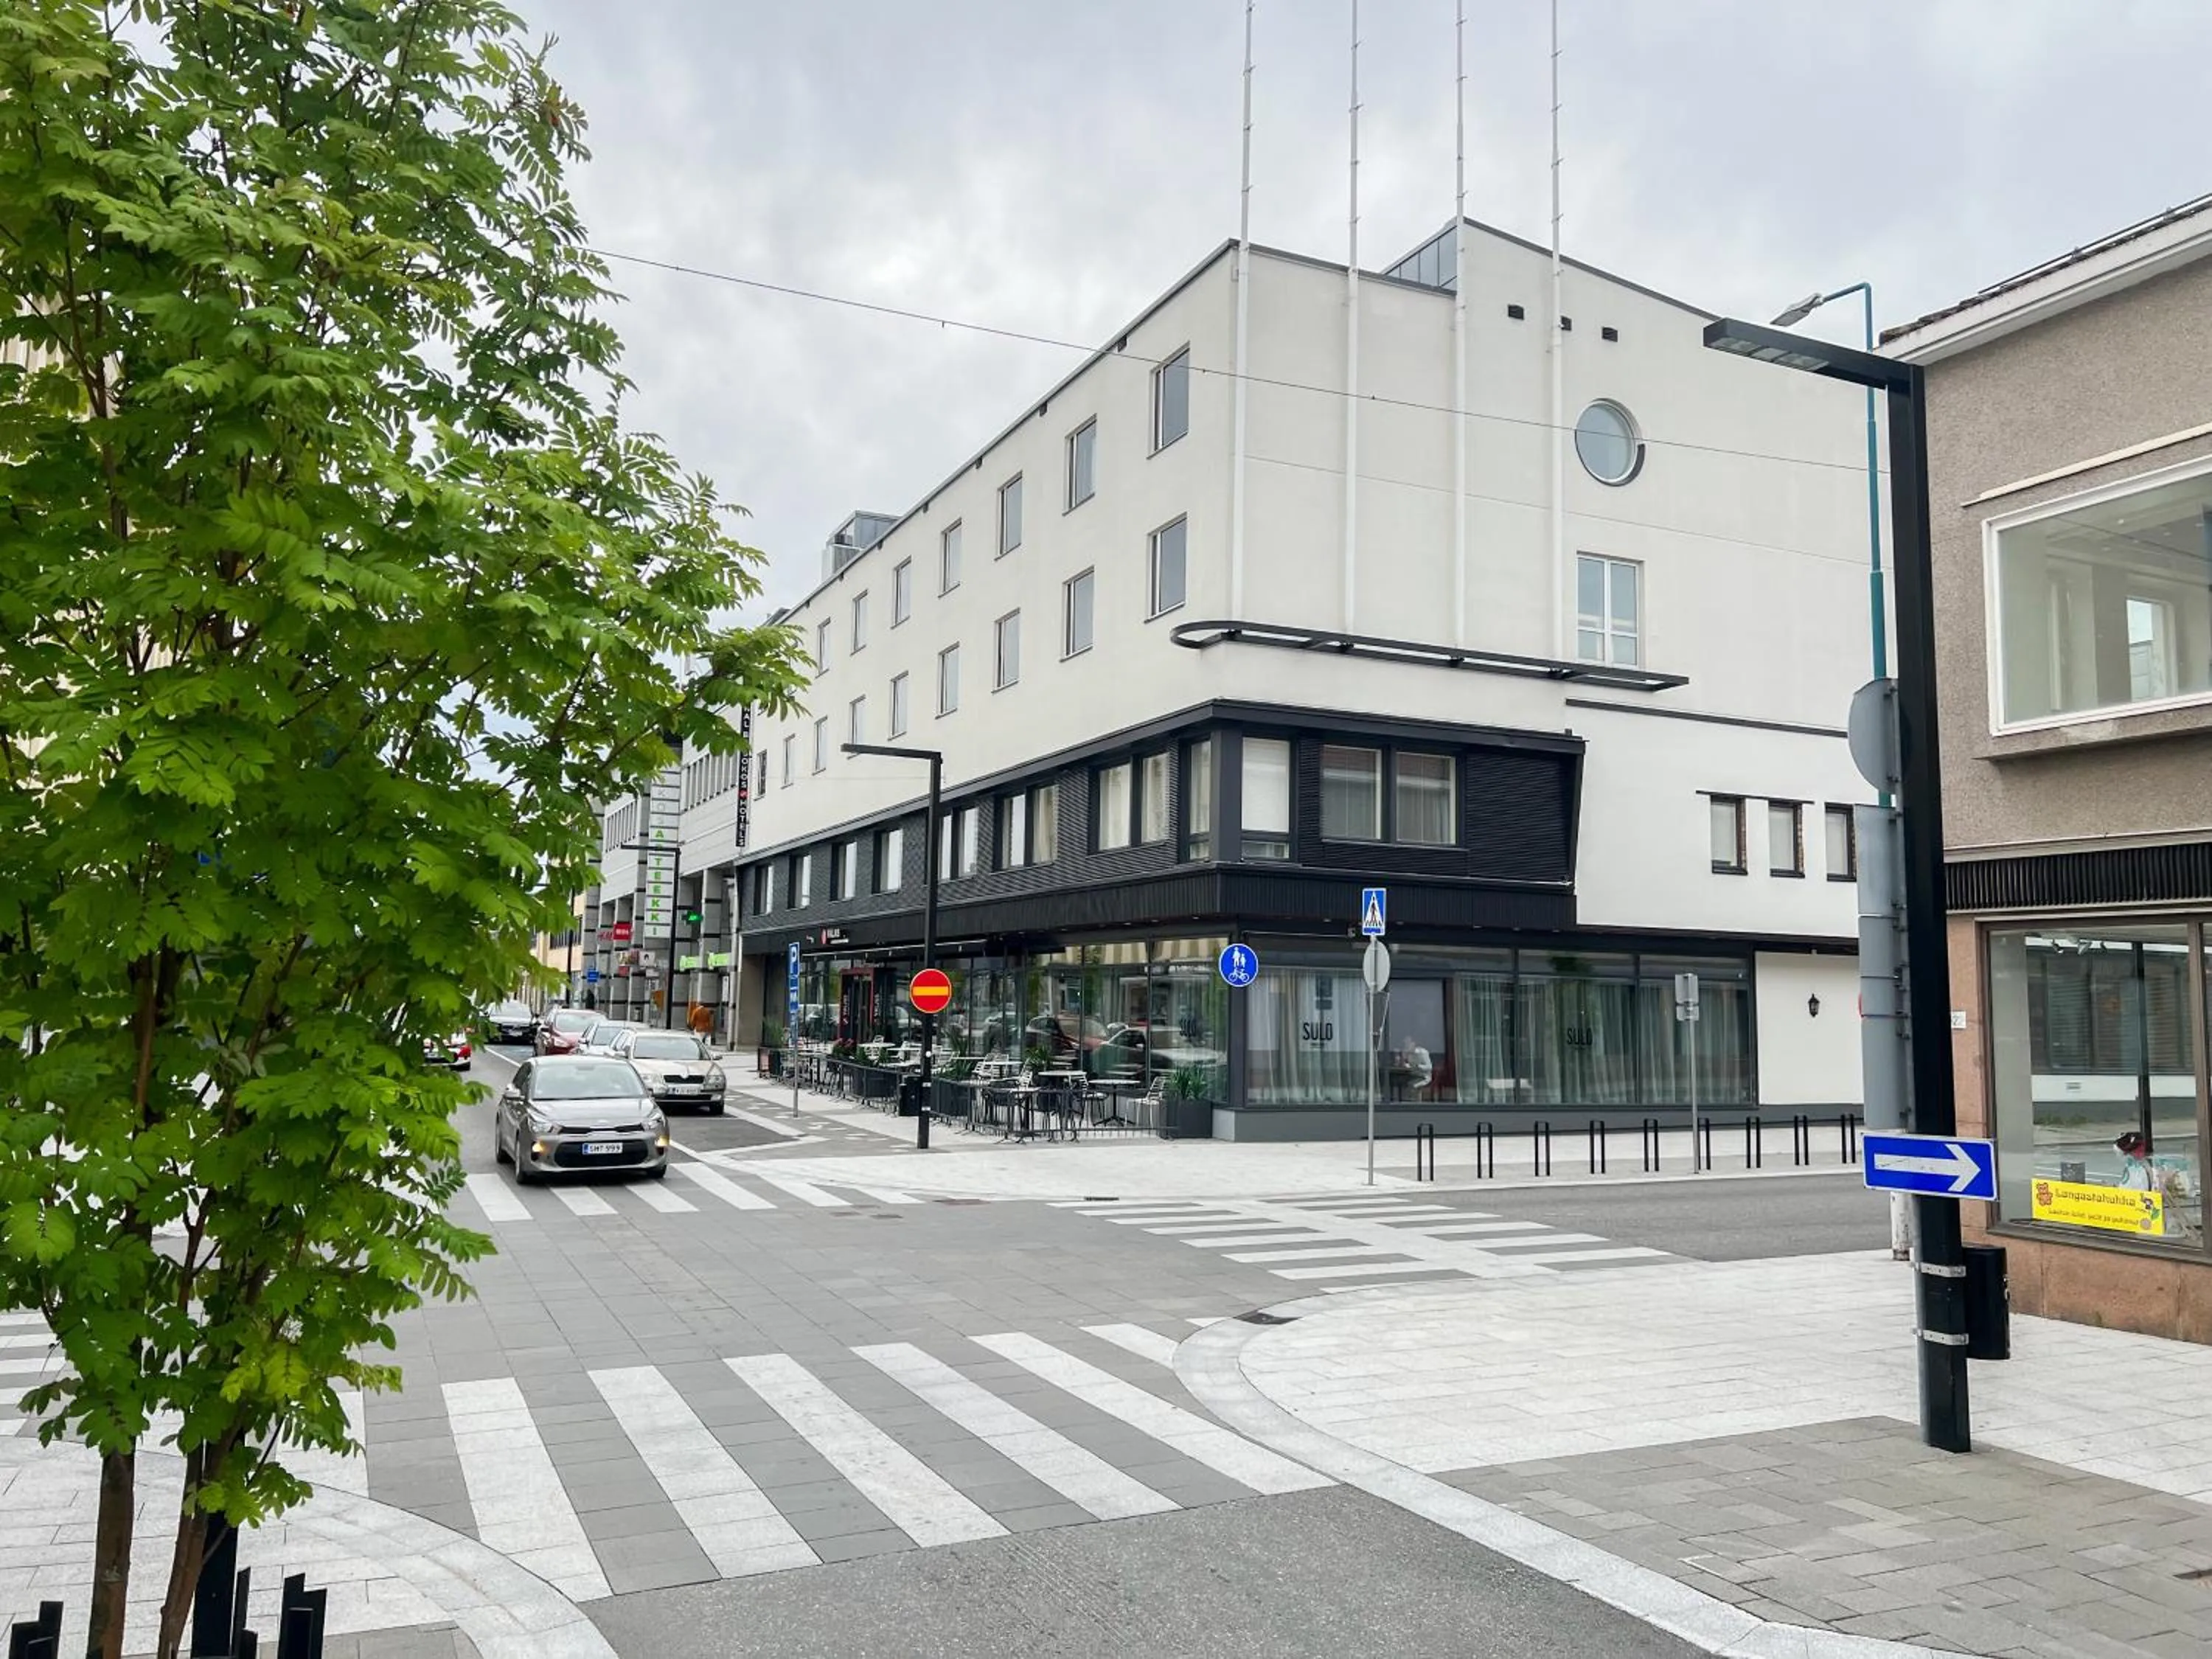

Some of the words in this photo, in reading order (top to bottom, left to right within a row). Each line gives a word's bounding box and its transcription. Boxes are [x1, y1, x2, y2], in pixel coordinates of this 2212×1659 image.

[737, 799, 747, 846] HOTELS
[650, 830, 664, 936] ATEEKKI
[1302, 1022, 1333, 1040] SULO
[1567, 1027, 1593, 1046] SULO
